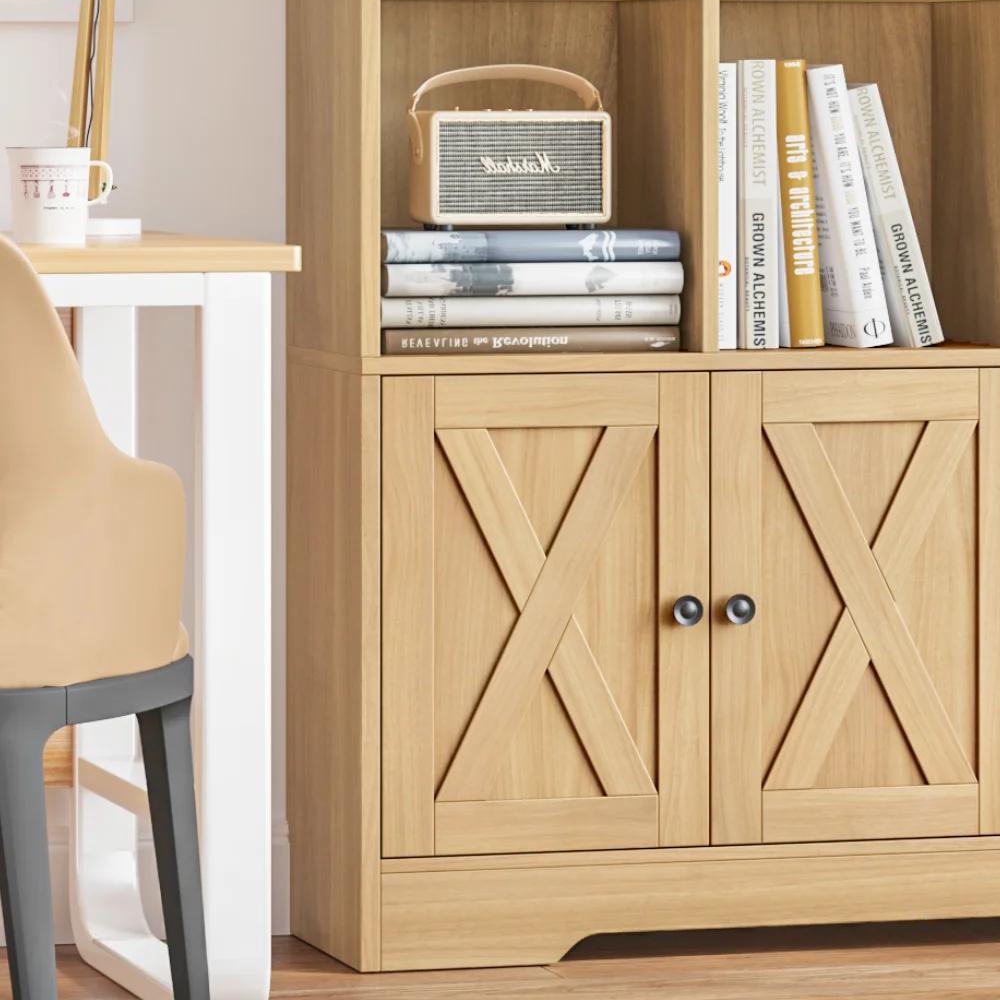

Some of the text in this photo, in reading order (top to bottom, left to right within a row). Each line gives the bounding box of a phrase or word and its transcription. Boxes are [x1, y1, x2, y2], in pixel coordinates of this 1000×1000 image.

[752, 109, 766, 186] ALCHEMIST
[784, 134, 810, 164] arts
[866, 130, 896, 201] ALCHEMIST
[788, 186, 816, 276] architecture
[752, 213, 766, 349] GROWN ALCHEMIS
[890, 223, 932, 347] GROWN ALCHEMIS
